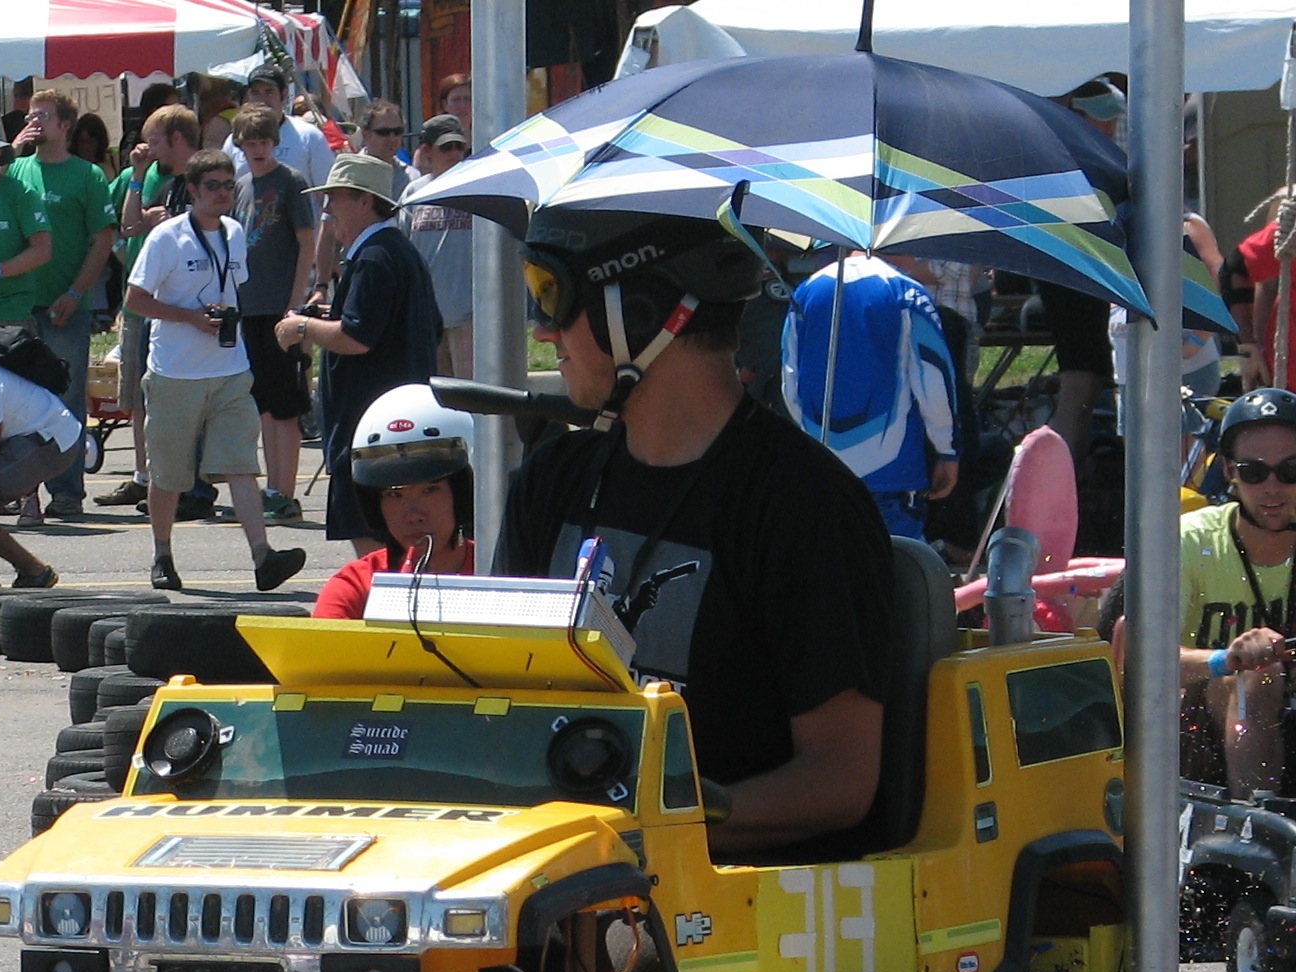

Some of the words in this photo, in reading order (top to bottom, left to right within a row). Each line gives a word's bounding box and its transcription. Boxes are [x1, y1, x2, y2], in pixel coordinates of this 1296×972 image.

[350, 723, 409, 739] Suicide
[349, 740, 400, 756] Squad
[96, 804, 505, 823] HUMMER
